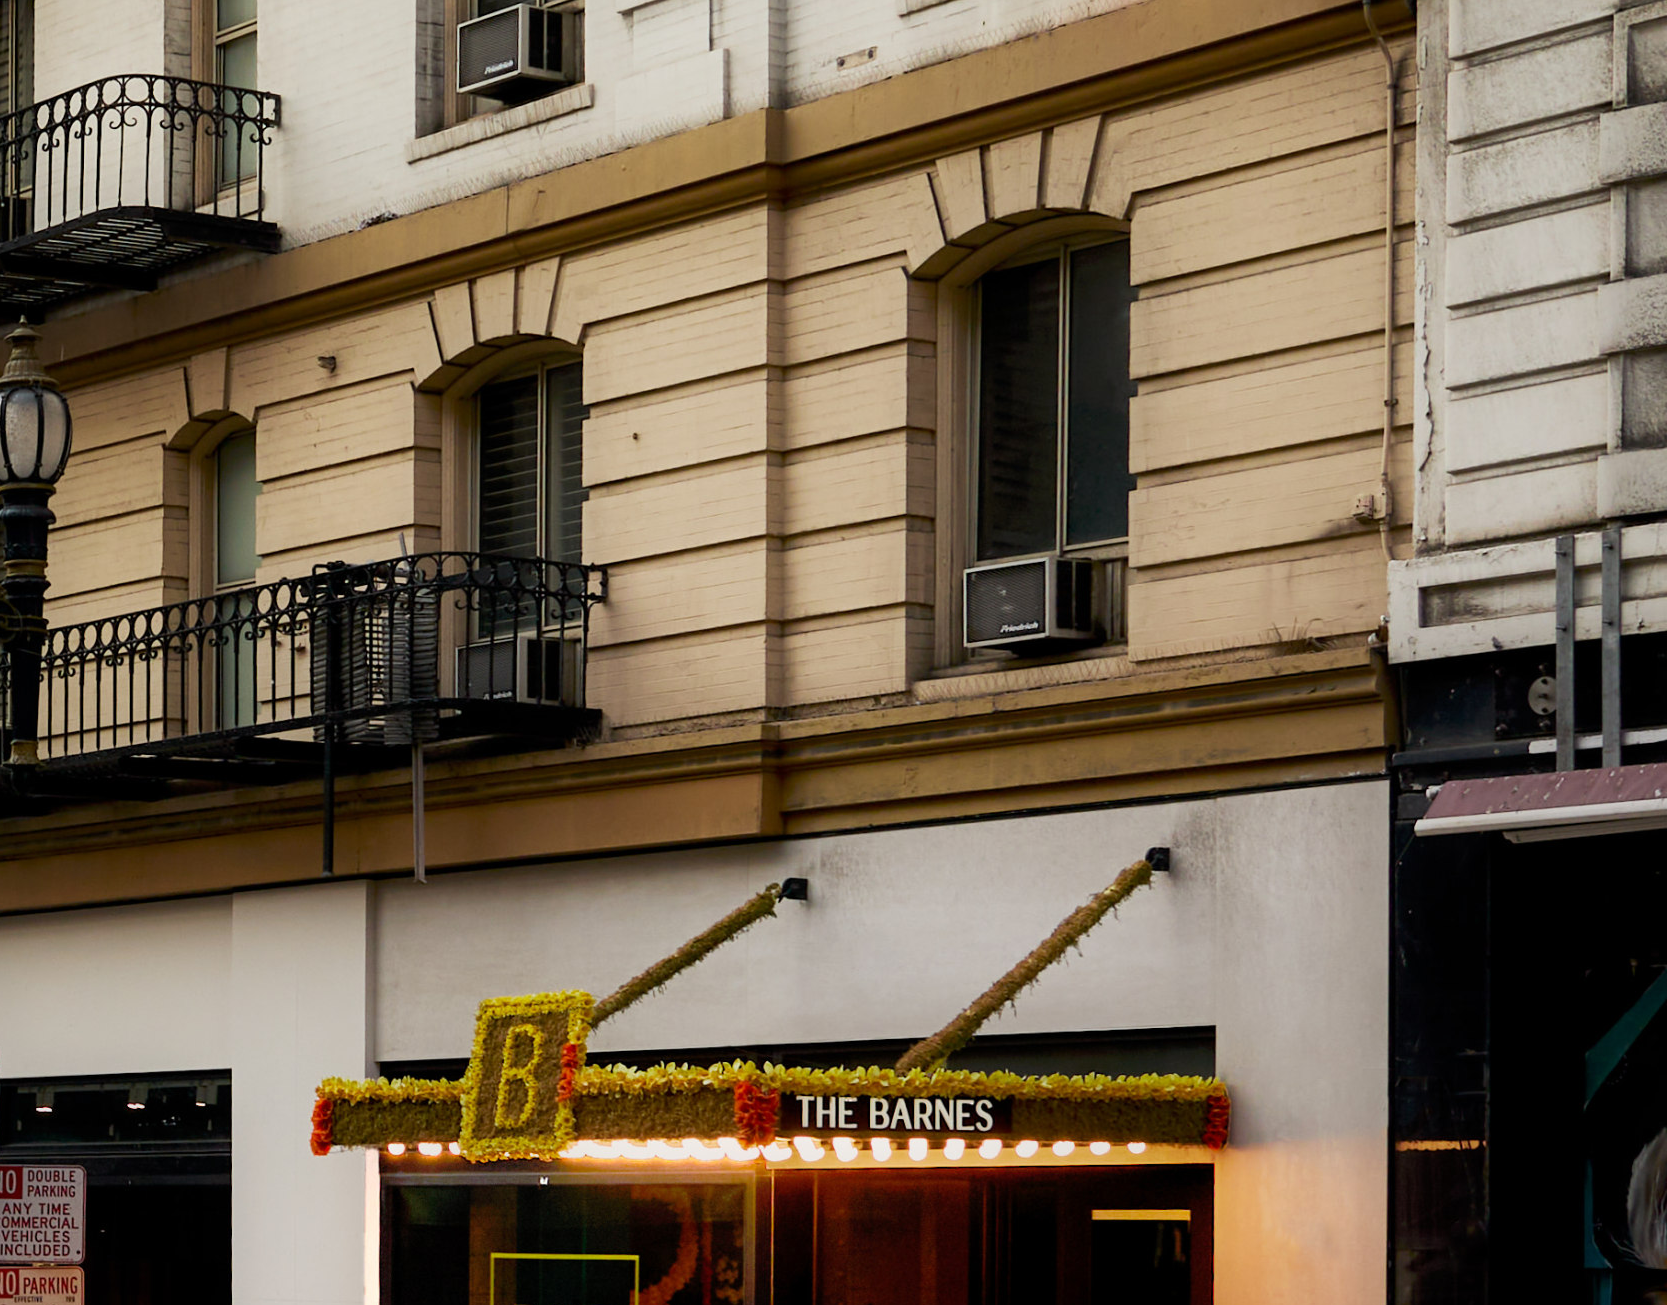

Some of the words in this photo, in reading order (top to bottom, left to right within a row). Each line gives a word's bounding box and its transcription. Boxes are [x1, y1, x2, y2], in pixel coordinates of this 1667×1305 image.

[494, 1023, 544, 1129] B
[797, 1095, 858, 1129] THE
[869, 1098, 994, 1132] BARNES
[27, 1170, 76, 1183] DOUBLE
[27, 1185, 76, 1198] PARKING
[2, 1203, 32, 1215] ANY
[38, 1203, 71, 1215] TIME
[1, 1230, 70, 1242] VEHICLES
[0, 1244, 70, 1256] INCLUDED
[23, 1276, 78, 1294] PARKING
